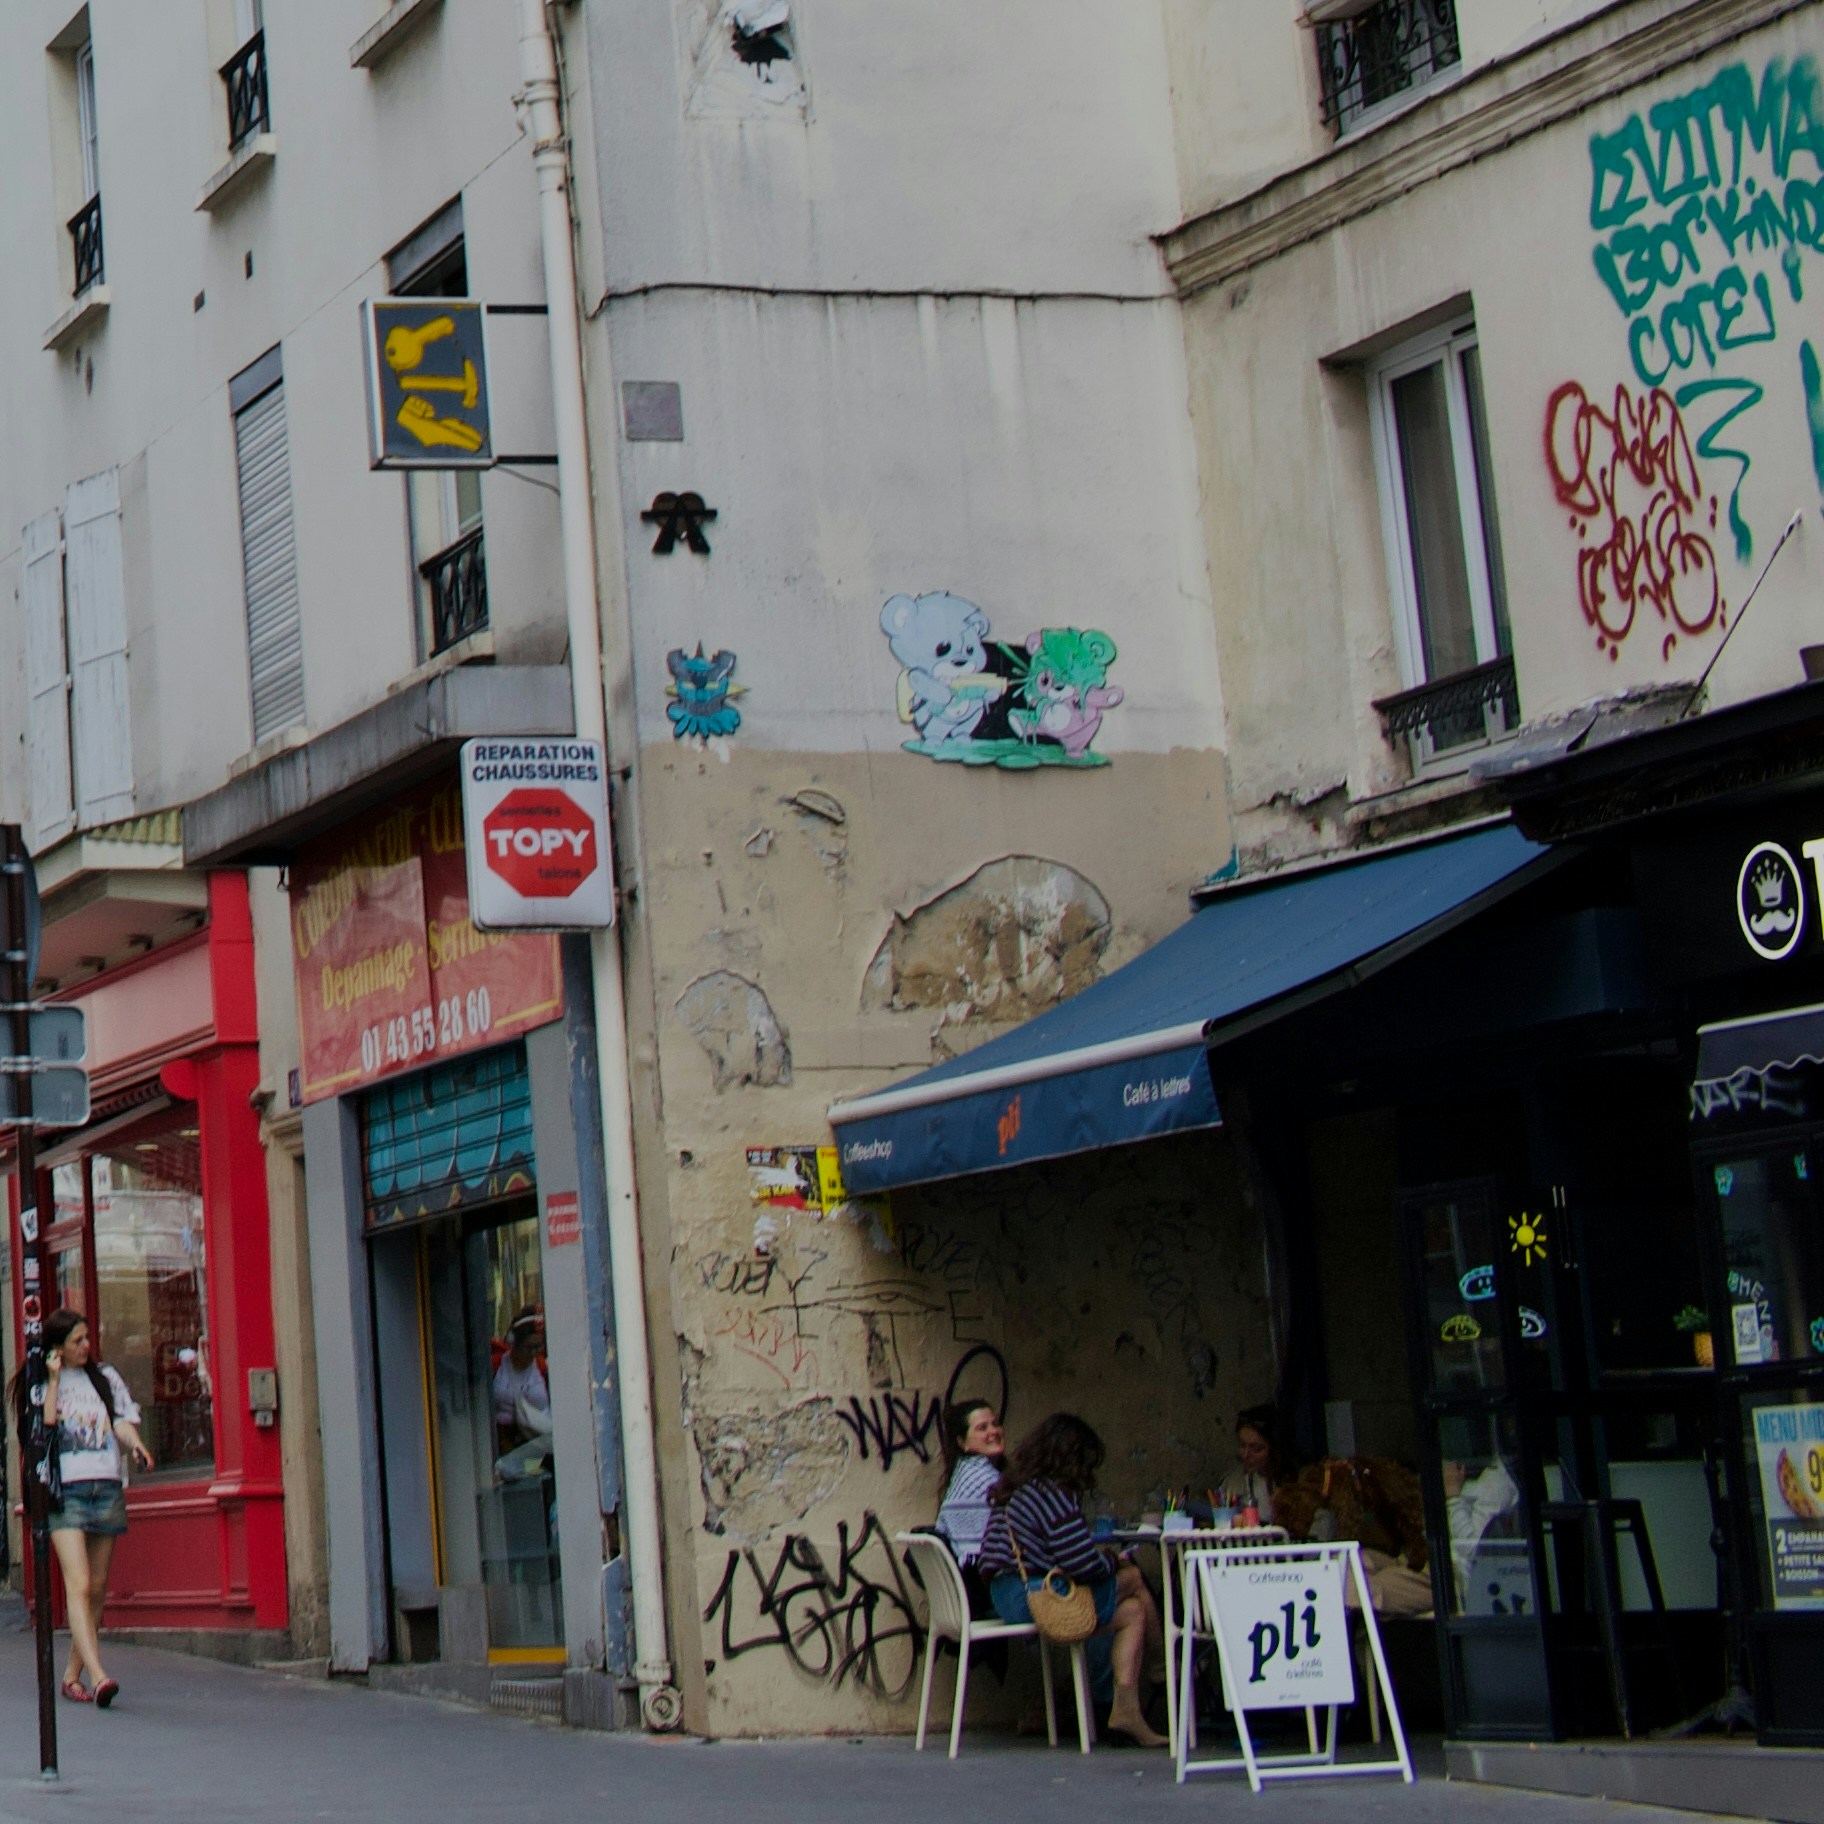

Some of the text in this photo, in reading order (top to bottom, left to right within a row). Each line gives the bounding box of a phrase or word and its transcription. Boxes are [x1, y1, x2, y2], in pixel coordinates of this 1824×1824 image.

[475, 744, 595, 761] REPARATION
[472, 764, 599, 782] CHAUSSURES
[489, 828, 590, 857] TOPY
[361, 985, 491, 1073] 01 43 55 28 60
[1123, 1081, 1150, 1108] Café
[1161, 1075, 1191, 1100] lettres
[997, 1094, 1022, 1157] pli
[843, 1138, 894, 1166] Coffeeshop
[1758, 1408, 1795, 1445] MENU
[1776, 1527, 1788, 1555] 2
[1248, 1588, 1321, 1684] pli
